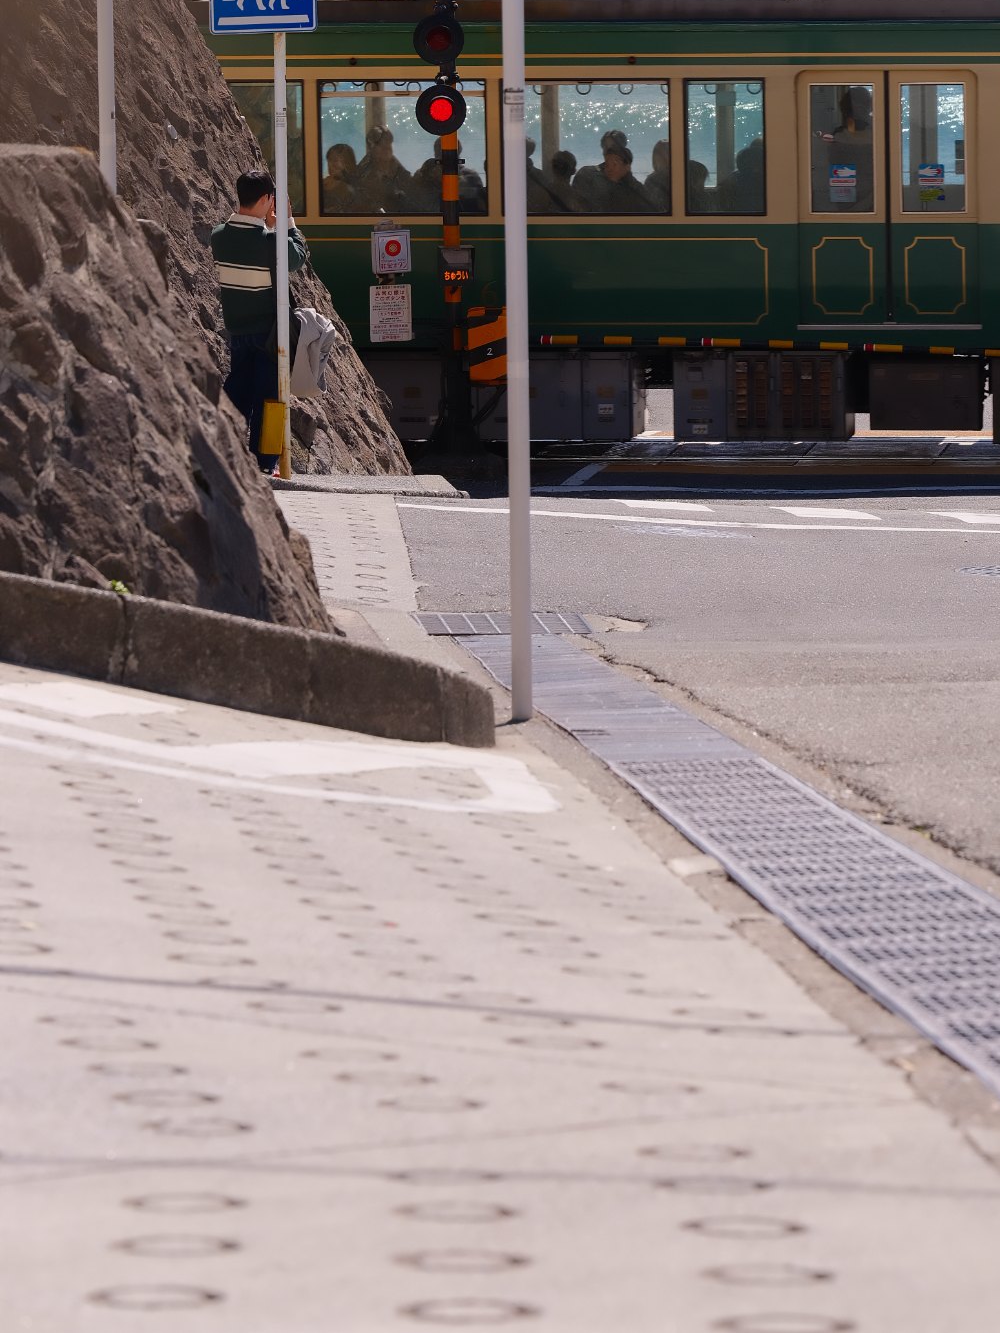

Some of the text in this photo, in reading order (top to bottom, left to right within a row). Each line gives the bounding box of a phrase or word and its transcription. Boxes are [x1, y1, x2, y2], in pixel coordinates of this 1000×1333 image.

[444, 270, 468, 280] ちゅうい
[486, 347, 493, 355] 2
